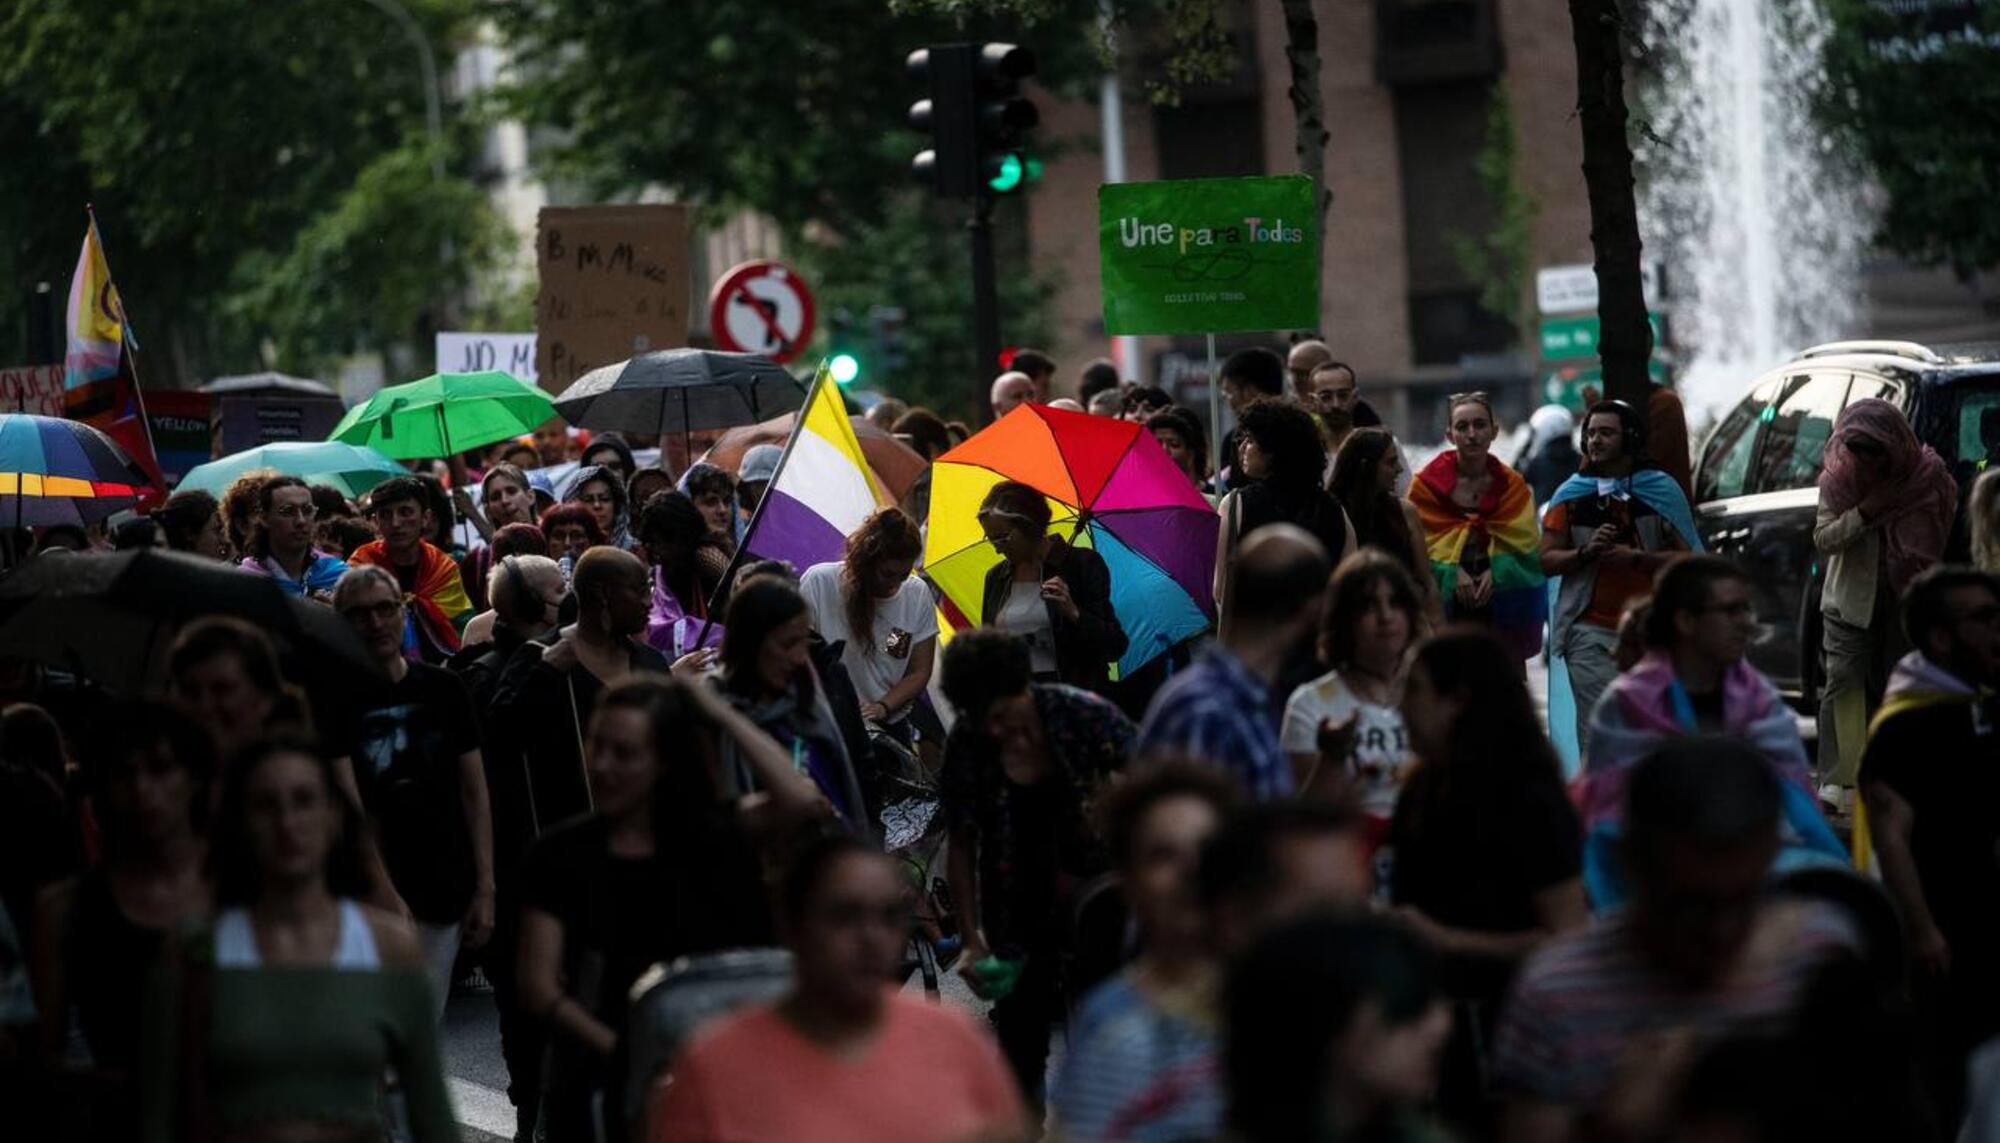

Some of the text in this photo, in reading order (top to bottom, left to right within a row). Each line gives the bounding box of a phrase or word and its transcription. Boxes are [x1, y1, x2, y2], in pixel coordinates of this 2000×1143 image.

[1119, 217, 1303, 254] Une para Todes
[153, 416, 208, 432] YELLOW
